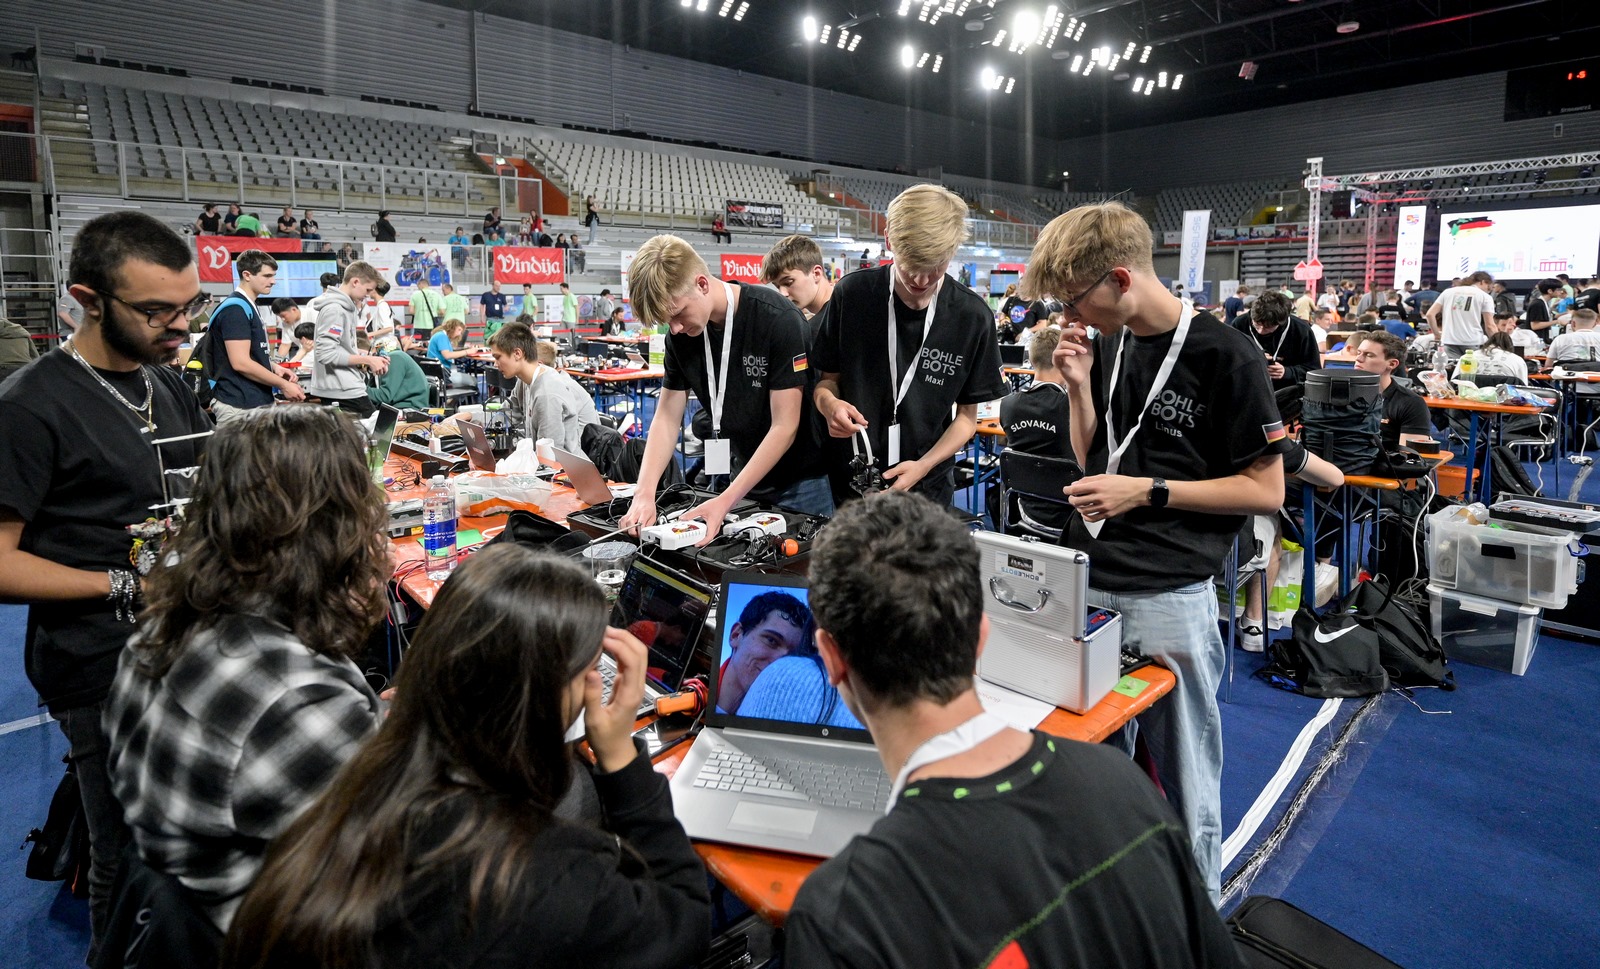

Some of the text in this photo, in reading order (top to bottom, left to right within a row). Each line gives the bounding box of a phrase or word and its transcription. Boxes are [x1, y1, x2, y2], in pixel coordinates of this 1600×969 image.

[497, 253, 560, 276] Vindija
[723, 259, 762, 278] Vindij
[1188, 267, 1197, 288] SICK
[921, 347, 964, 366] BOHLE
[922, 360, 956, 376] BOTS
[925, 374, 945, 386] Maxi
[1151, 402, 1195, 428] BOTS
[1010, 419, 1056, 434] SLOVAKIA
[1155, 421, 1183, 437] Linus
[429, 510, 437, 556] smatwater
